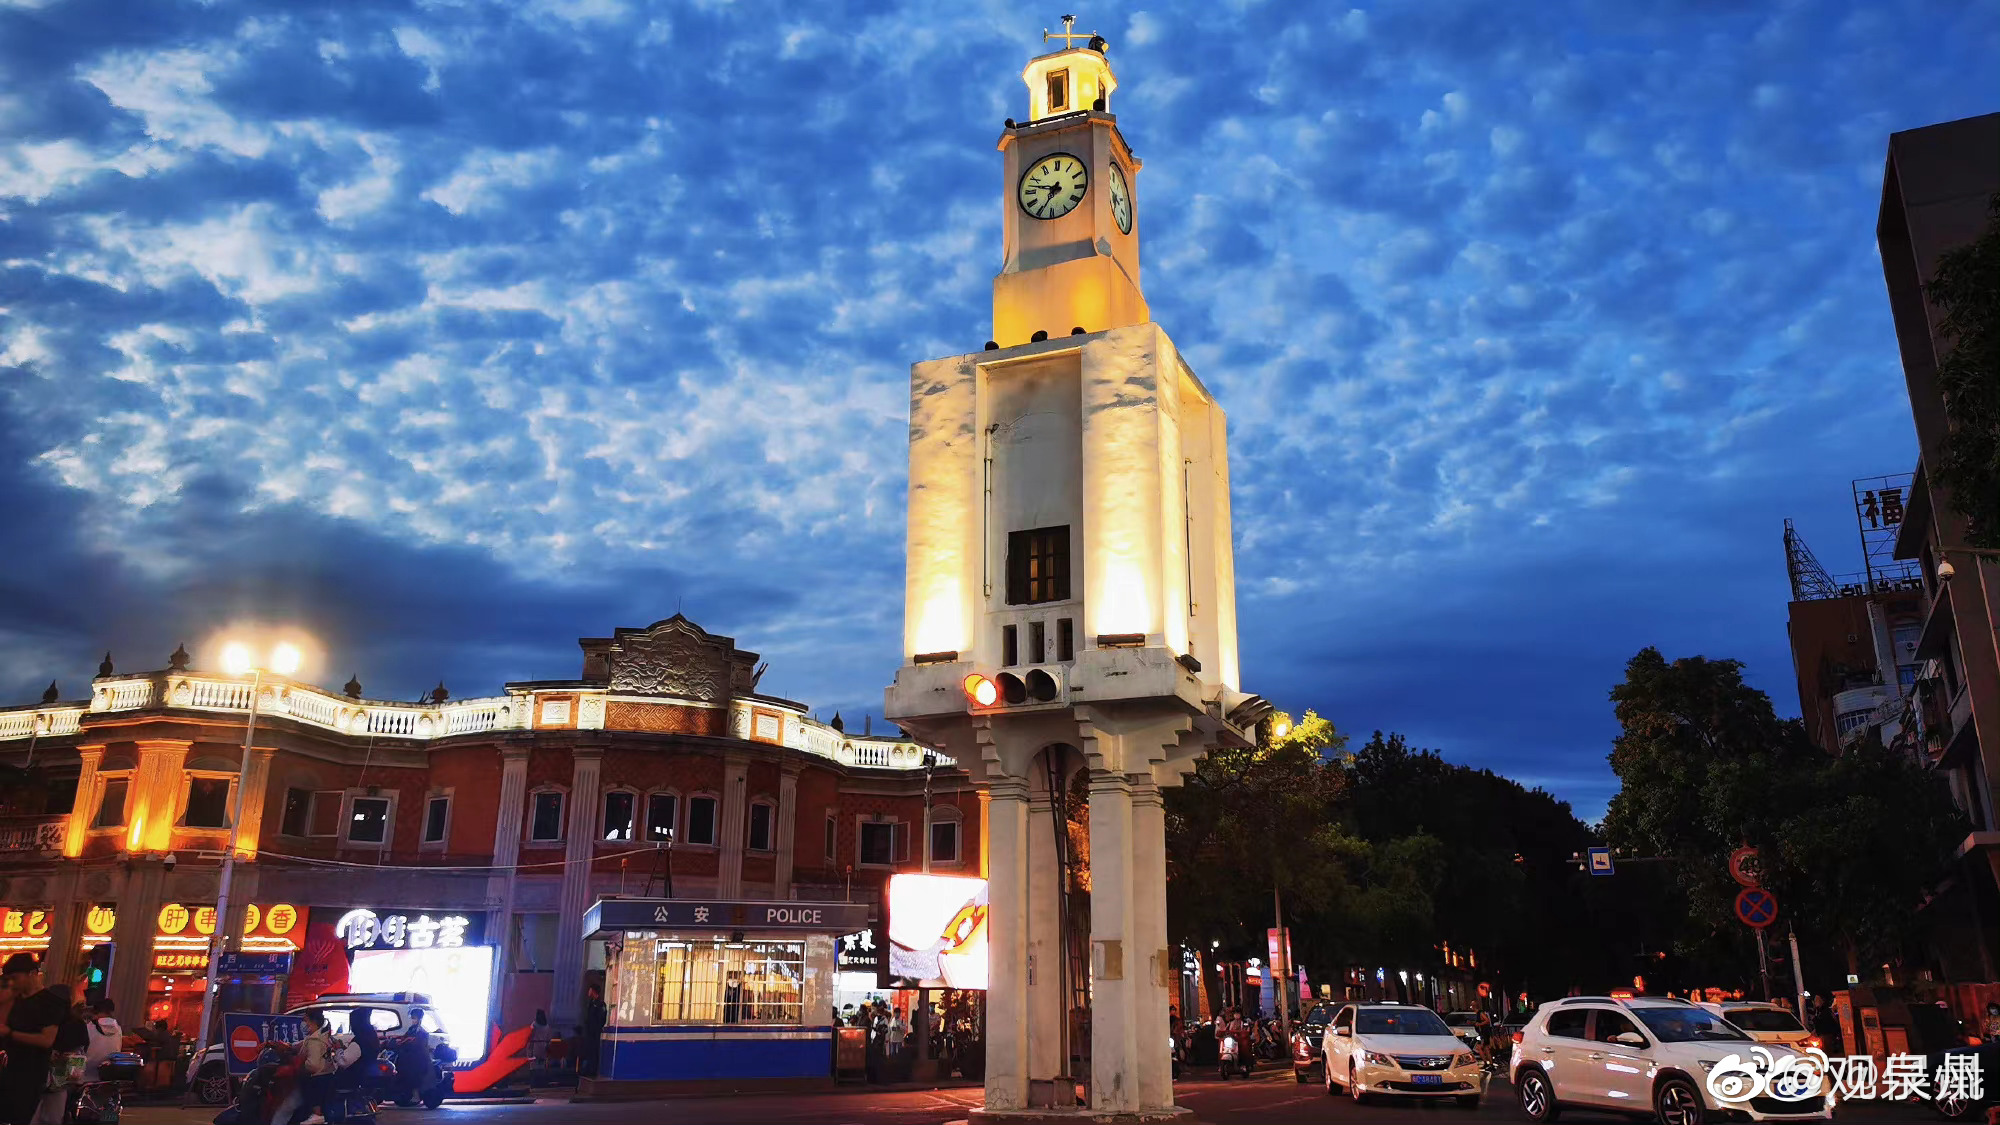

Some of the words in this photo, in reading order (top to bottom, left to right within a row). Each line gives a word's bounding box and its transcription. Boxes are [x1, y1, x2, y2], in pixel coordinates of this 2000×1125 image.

[1862, 488, 1904, 528] 福
[653, 905, 710, 923] 公安
[766, 908, 822, 924] POLICE
